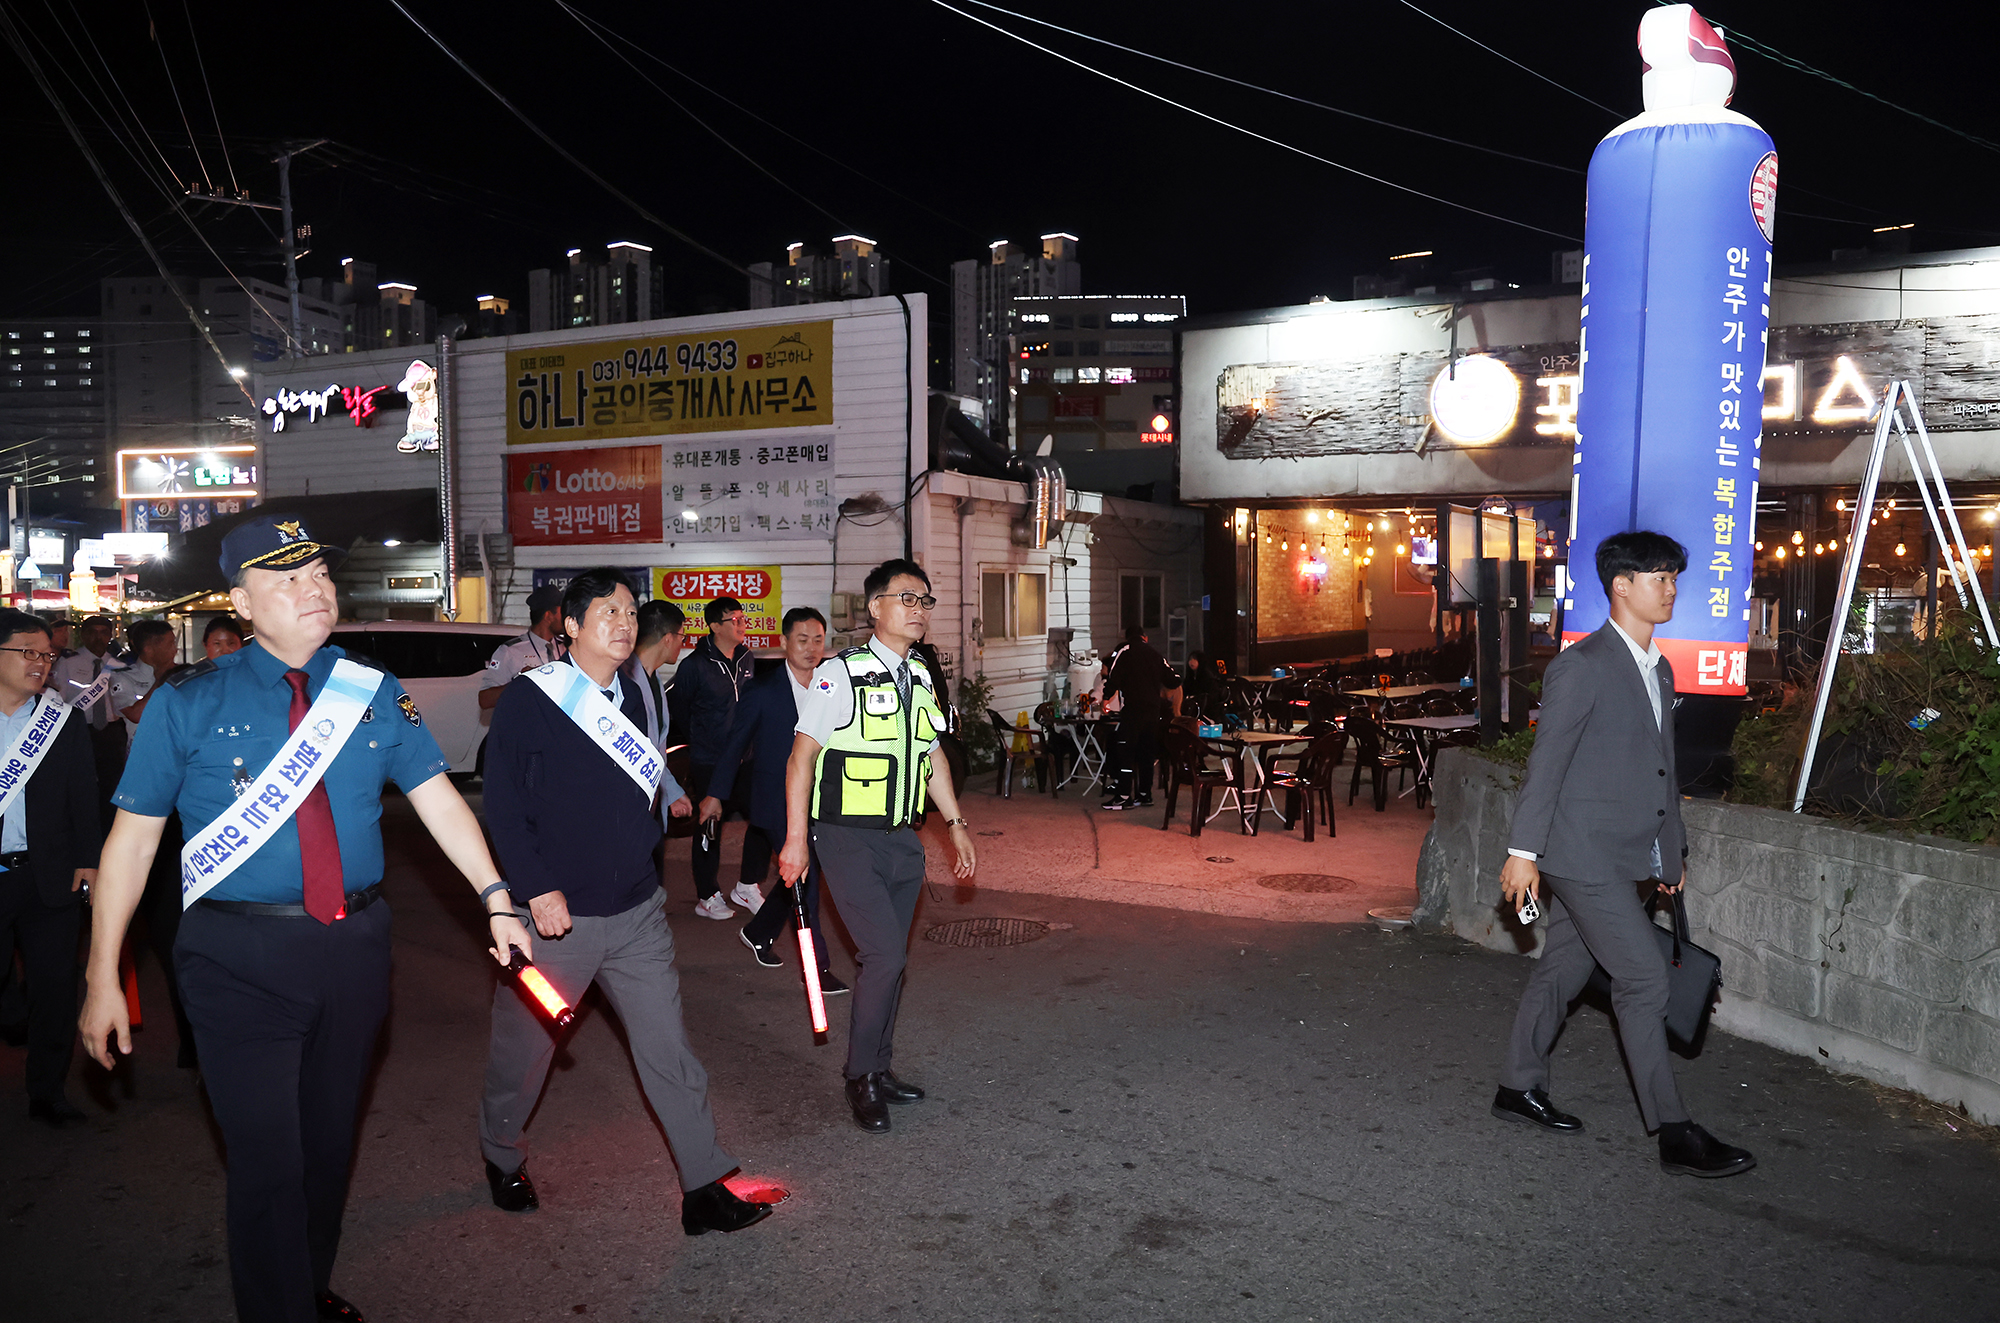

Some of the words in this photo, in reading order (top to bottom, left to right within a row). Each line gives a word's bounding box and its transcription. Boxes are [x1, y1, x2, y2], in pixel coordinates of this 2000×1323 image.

[1721, 246, 1750, 353] 안주가
[592, 359, 621, 382] 031
[624, 347, 670, 378] 944
[676, 339, 738, 374] 9433
[765, 348, 814, 368] 집구하나
[517, 370, 589, 430] 하나
[1714, 361, 1744, 467] 맛있는
[672, 448, 742, 469] 휴대폰개통
[756, 443, 829, 465] 중고폰매입
[555, 467, 617, 494] Lotto
[531, 502, 641, 536] 복권판매점
[672, 515, 741, 534] 인터넷가입
[1707, 477, 1737, 618] 복합주점
[670, 573, 763, 597] 상가주차장
[18, 704, 62, 759] 범죄예방
[611, 730, 646, 766] 범죄
[277, 739, 323, 788] 범죄
[240, 782, 290, 830] 없는
[189, 824, 250, 878] 안전한
